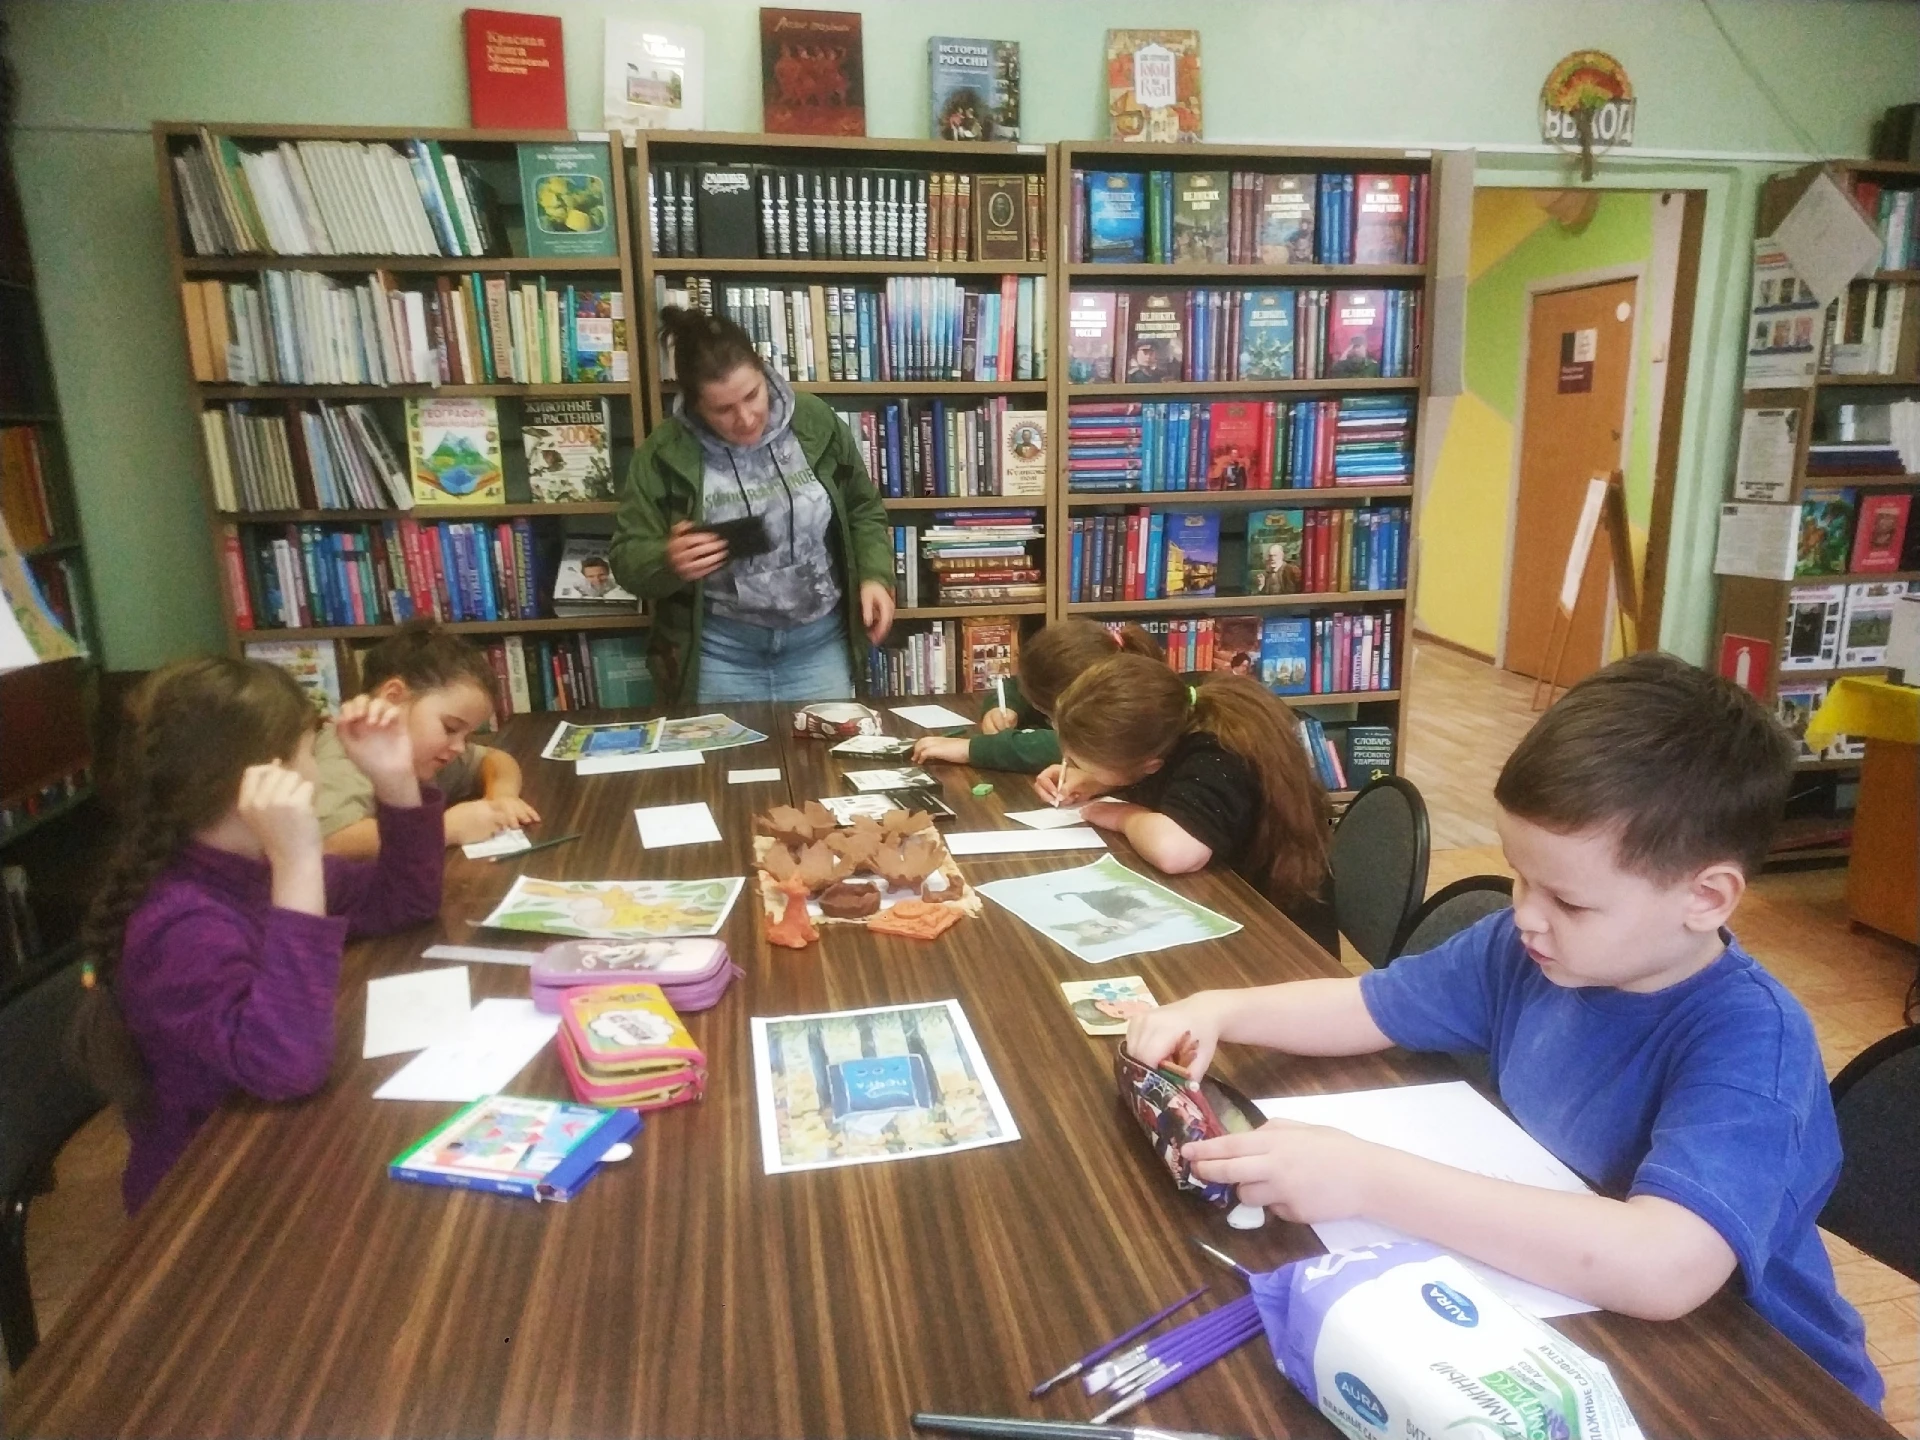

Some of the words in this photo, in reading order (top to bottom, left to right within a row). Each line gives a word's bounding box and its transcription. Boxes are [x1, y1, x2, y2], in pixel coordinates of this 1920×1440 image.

[939, 44, 988, 55] ИСТОРИЯ
[939, 54, 988, 67] РОССИИ
[525, 400, 593, 413] ЖИВОТНЫЕ
[541, 412, 603, 424] РАСТЕНИЯ
[557, 426, 588, 443] 300
[1353, 737, 1391, 746] СЛОВАРЬ
[1430, 1287, 1473, 1322] AURA
[1538, 1345, 1589, 1386] САЛФЕТКИ
[1341, 1381, 1382, 1417] AURA
